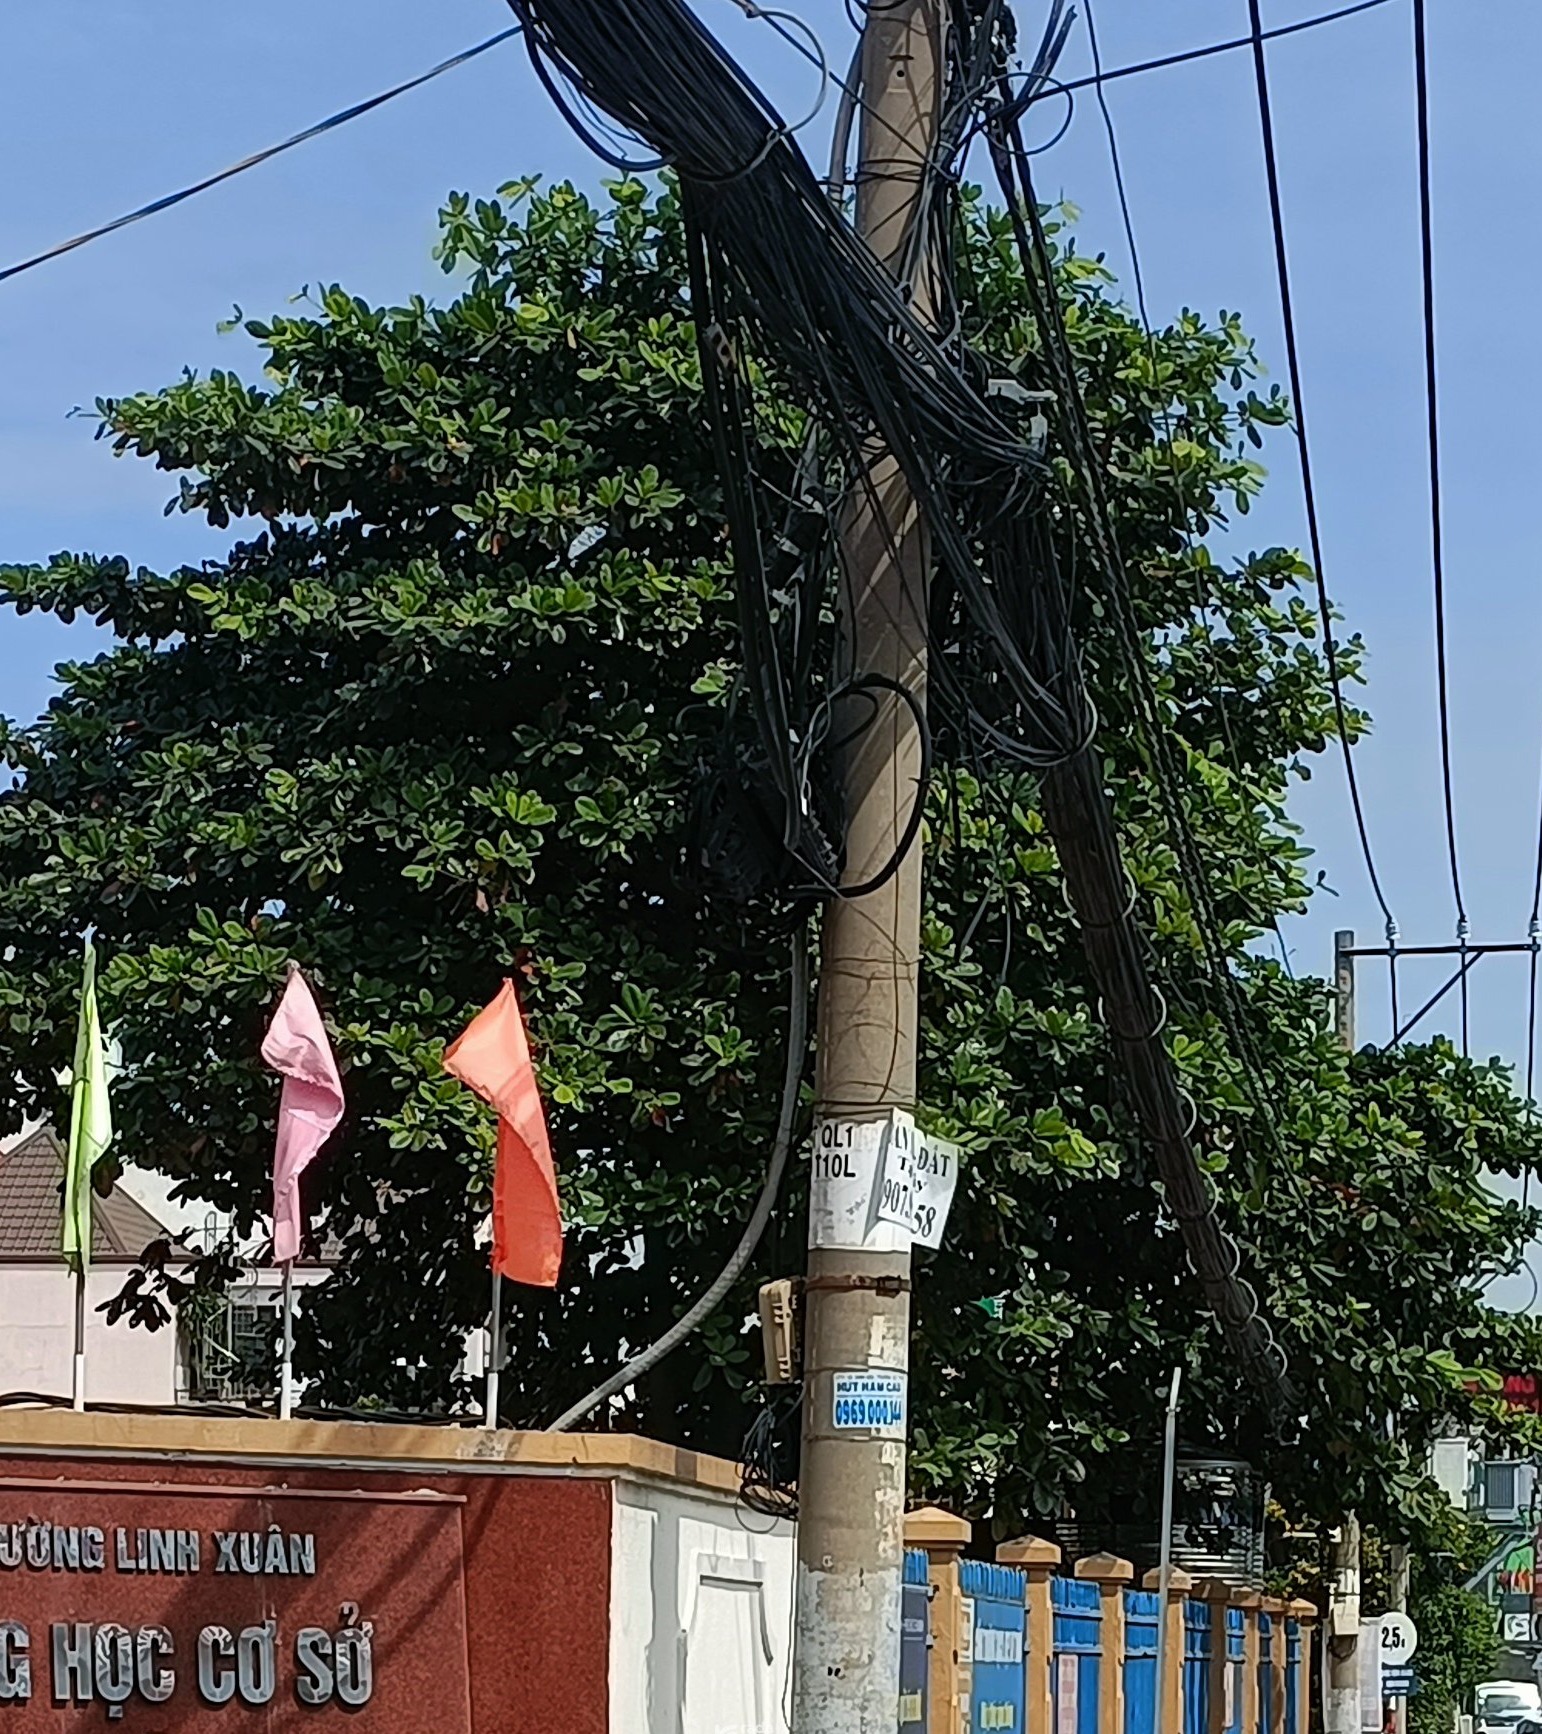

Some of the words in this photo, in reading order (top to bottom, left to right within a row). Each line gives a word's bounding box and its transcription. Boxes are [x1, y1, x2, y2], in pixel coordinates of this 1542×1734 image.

[115, 1526, 201, 1572] LINH
[213, 1523, 317, 1575] XUÂN
[51, 1622, 175, 1718] HỌC
[198, 1619, 278, 1703] CƠ
[297, 1601, 374, 1705] SỞ
